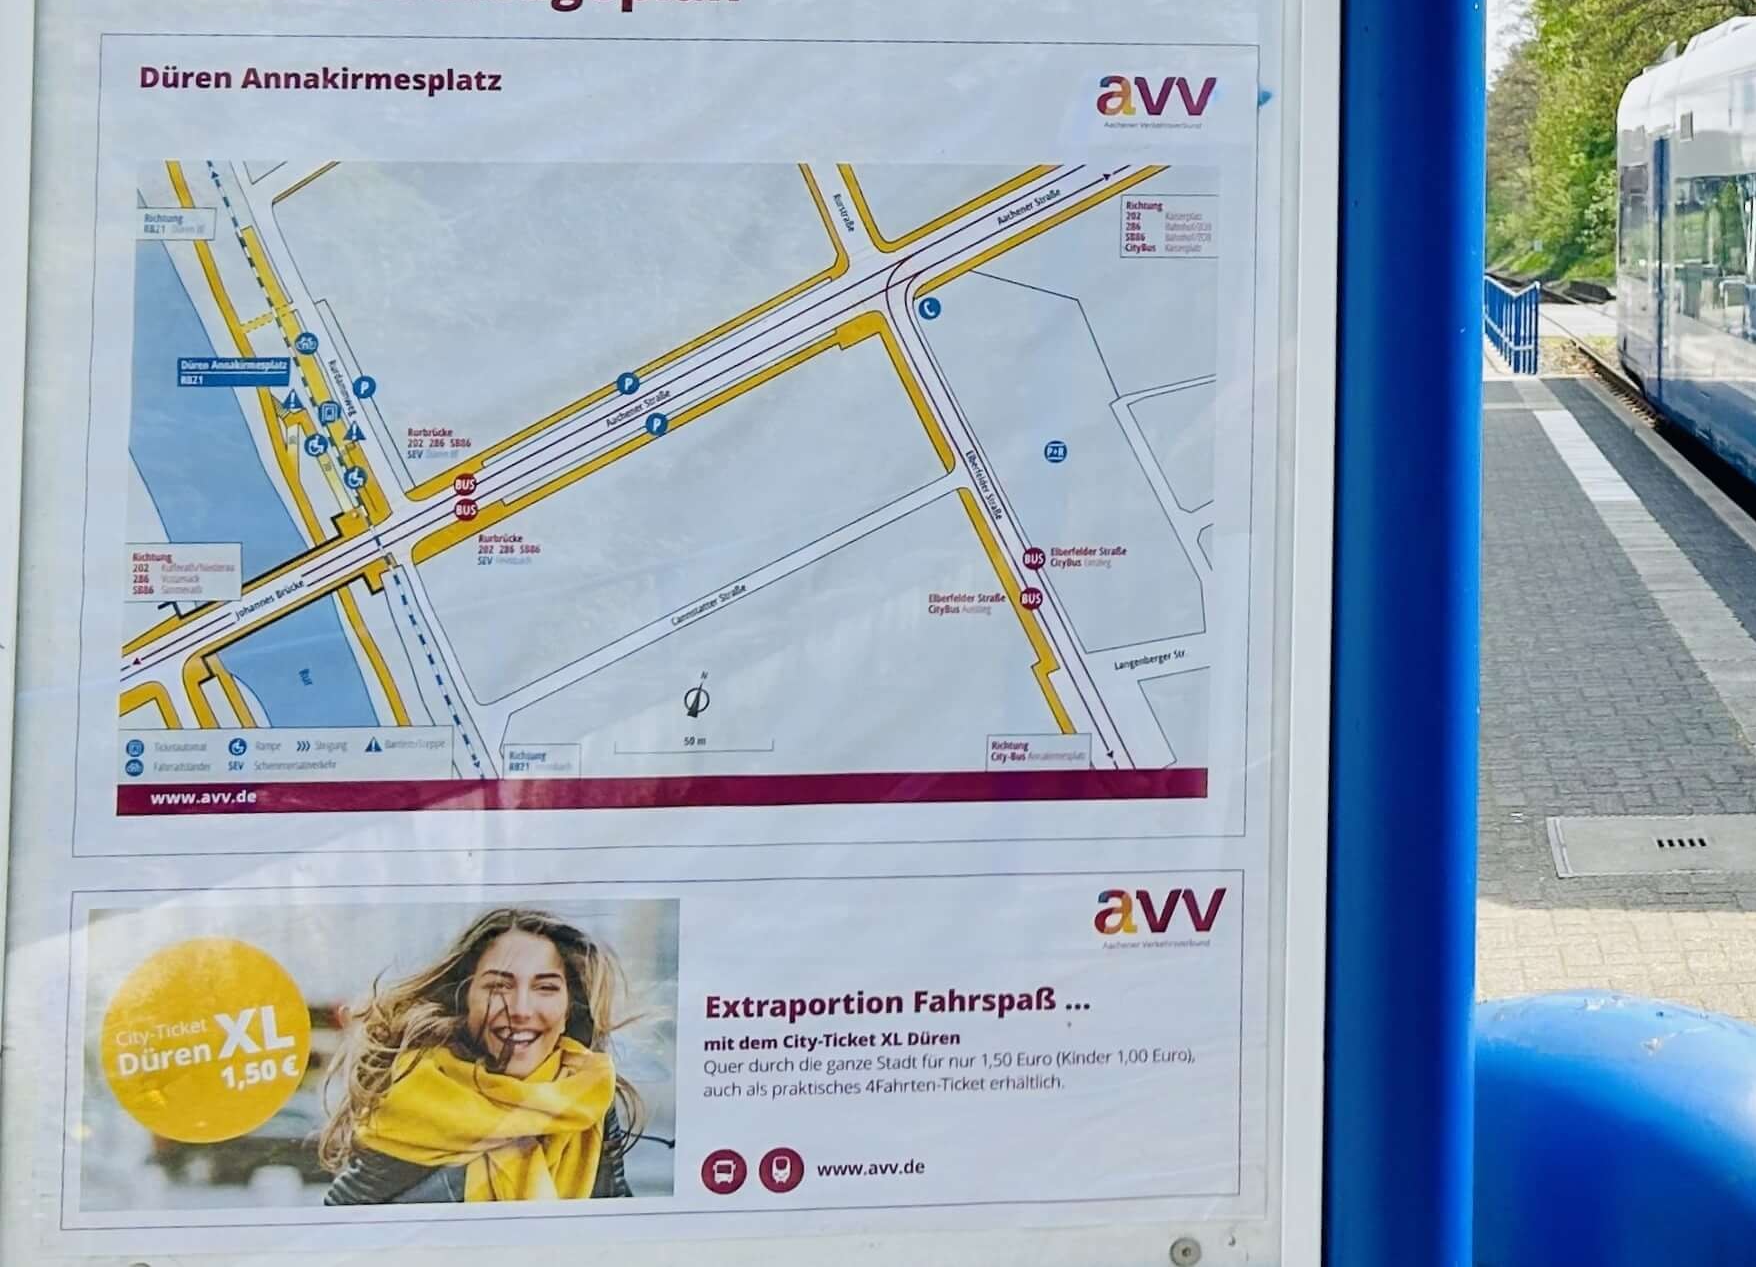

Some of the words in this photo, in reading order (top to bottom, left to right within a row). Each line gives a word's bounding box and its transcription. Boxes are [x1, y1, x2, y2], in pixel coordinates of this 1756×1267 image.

[139, 65, 232, 89] Düren
[241, 67, 502, 96] Annakirmesplatz
[1096, 75, 1217, 116] avv
[1126, 201, 1163, 212] Richtung
[408, 439, 423, 448] 202
[429, 439, 445, 448] 286
[408, 450, 424, 459] SEV
[455, 479, 475, 490] BUS
[455, 504, 476, 515] BUS
[478, 545, 494, 554] 202
[1024, 553, 1044, 564] BUS
[1050, 547, 1098, 557] Elberfelder
[1099, 546, 1127, 556] Straße
[132, 552, 172, 563] Richtung
[478, 557, 493, 565] SEV
[1050, 559, 1081, 569] CityBus
[132, 564, 149, 573] 202
[928, 594, 975, 603] Elberfelder
[977, 593, 1006, 603] Straße
[1021, 593, 1042, 604] BUS
[928, 605, 960, 615] CityBus
[1114, 653, 1171, 671] Langenberger
[991, 741, 1029, 751] Richtung
[991, 751, 1026, 763] City-Bus
[228, 761, 244, 771] SEV
[150, 790, 257, 805] www.avv.de
[1094, 888, 1226, 934] avv
[706, 990, 903, 1024] Extraportion
[914, 986, 1056, 1018] Fahrspaß
[116, 1019, 208, 1047] City-Ticket
[214, 1005, 295, 1060] XL
[704, 1036, 734, 1051] mit
[739, 1035, 778, 1050] dem
[783, 1032, 876, 1052] City-Ticket
[881, 1032, 903, 1047] XL
[908, 1031, 960, 1046] Düren
[118, 1043, 212, 1076] Düren
[703, 1059, 743, 1077] Quer
[749, 1057, 794, 1073] durch
[800, 1057, 823, 1072] die
[826, 1058, 872, 1075] ganze
[876, 1055, 917, 1070] Stadt
[922, 1054, 945, 1069] für
[949, 1056, 976, 1068] nur
[981, 1052, 1012, 1069] 1,50
[1017, 1052, 1052, 1066] Euro
[1056, 1050, 1112, 1068] (Kinder
[1117, 1049, 1148, 1067] 1,00
[1152, 1048, 1196, 1064] Euro),
[221, 1059, 277, 1091] 1,50
[282, 1054, 299, 1077] €
[703, 1082, 742, 1097] auch
[746, 1081, 768, 1096] als
[772, 1079, 861, 1100] praktisches
[865, 1076, 985, 1094] 4Fahrten-Ticket
[989, 1074, 1064, 1090] erhältlich.
[817, 1158, 925, 1176] www.avv.de
